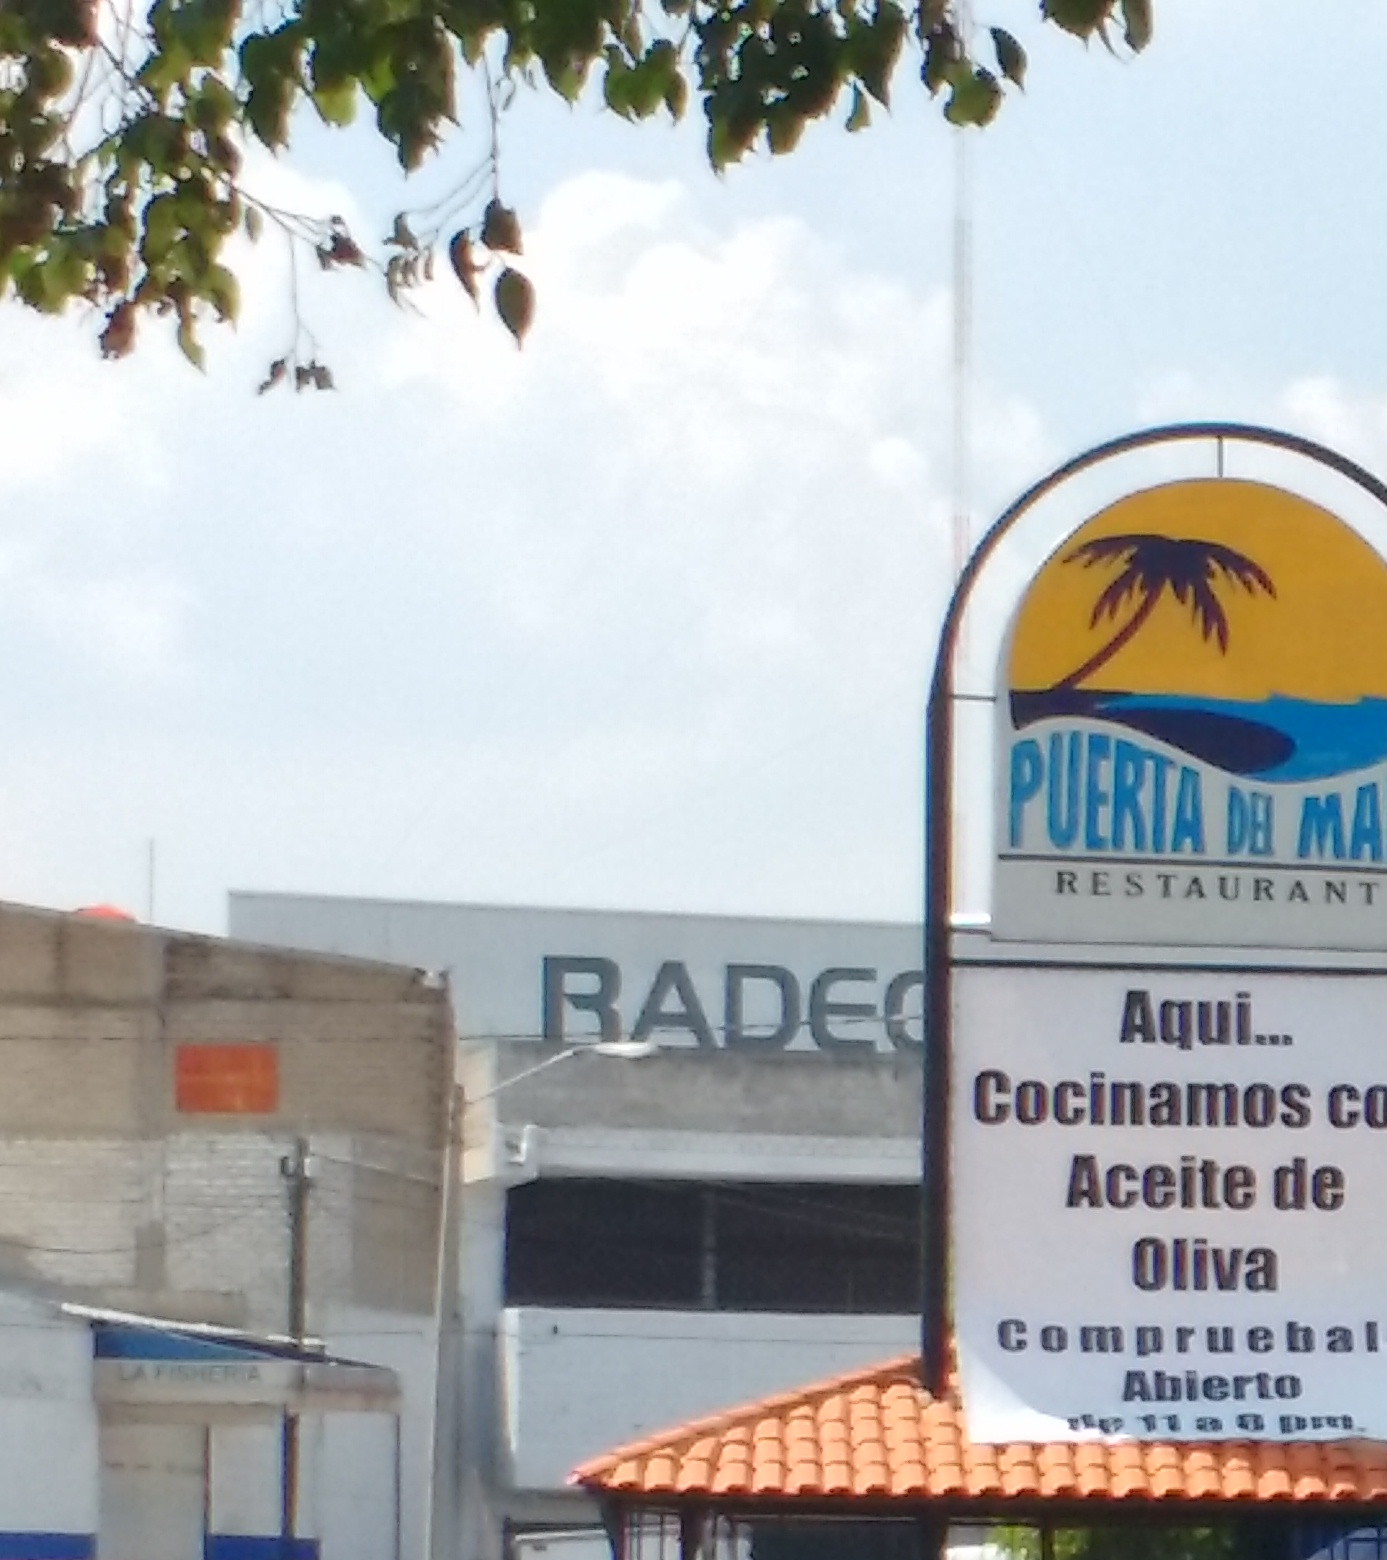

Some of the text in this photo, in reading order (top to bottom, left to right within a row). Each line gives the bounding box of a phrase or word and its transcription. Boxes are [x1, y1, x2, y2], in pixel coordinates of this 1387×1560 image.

[1008, 730, 1205, 854] PUERTA
[1226, 784, 1274, 856] DEL
[1054, 870, 1381, 905] RESTAURANT
[1119, 990, 1293, 1050] Aqui...
[973, 1070, 1312, 1129] Cocinamos
[1066, 1154, 1345, 1211] Aceite de
[1132, 1236, 1279, 1292] Oliva
[1122, 1370, 1303, 1402] Abierto
